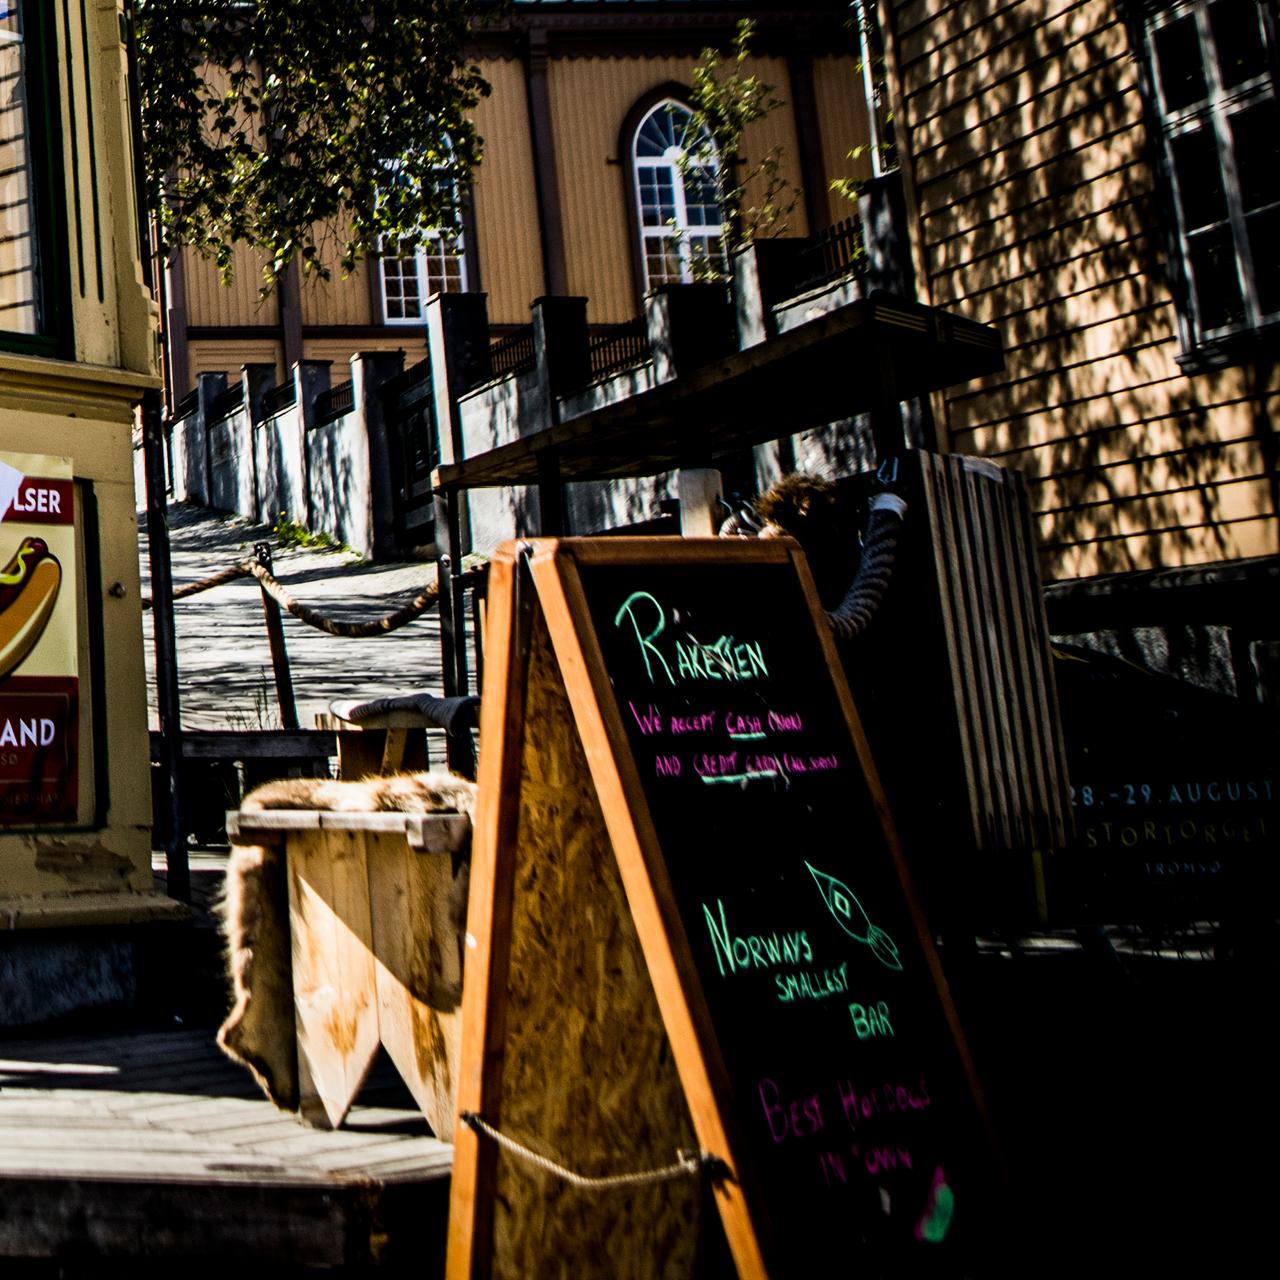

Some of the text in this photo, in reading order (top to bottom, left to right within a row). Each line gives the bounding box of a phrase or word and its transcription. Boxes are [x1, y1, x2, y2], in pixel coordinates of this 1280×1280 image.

[14, 488, 61, 513] LSER
[615, 590, 769, 687] RAKETTEN
[628, 699, 662, 736] WE
[725, 711, 762, 733] CASH
[655, 753, 681, 777] AND
[693, 750, 738, 775] CREDIT
[745, 754, 776, 773] CARD
[1168, 780, 1274, 805] AUGUST
[1085, 813, 1268, 849] STORTORGET
[701, 898, 814, 977] NORWAYS
[775, 960, 849, 1003] SMALLEST
[848, 999, 895, 1040] BAR
